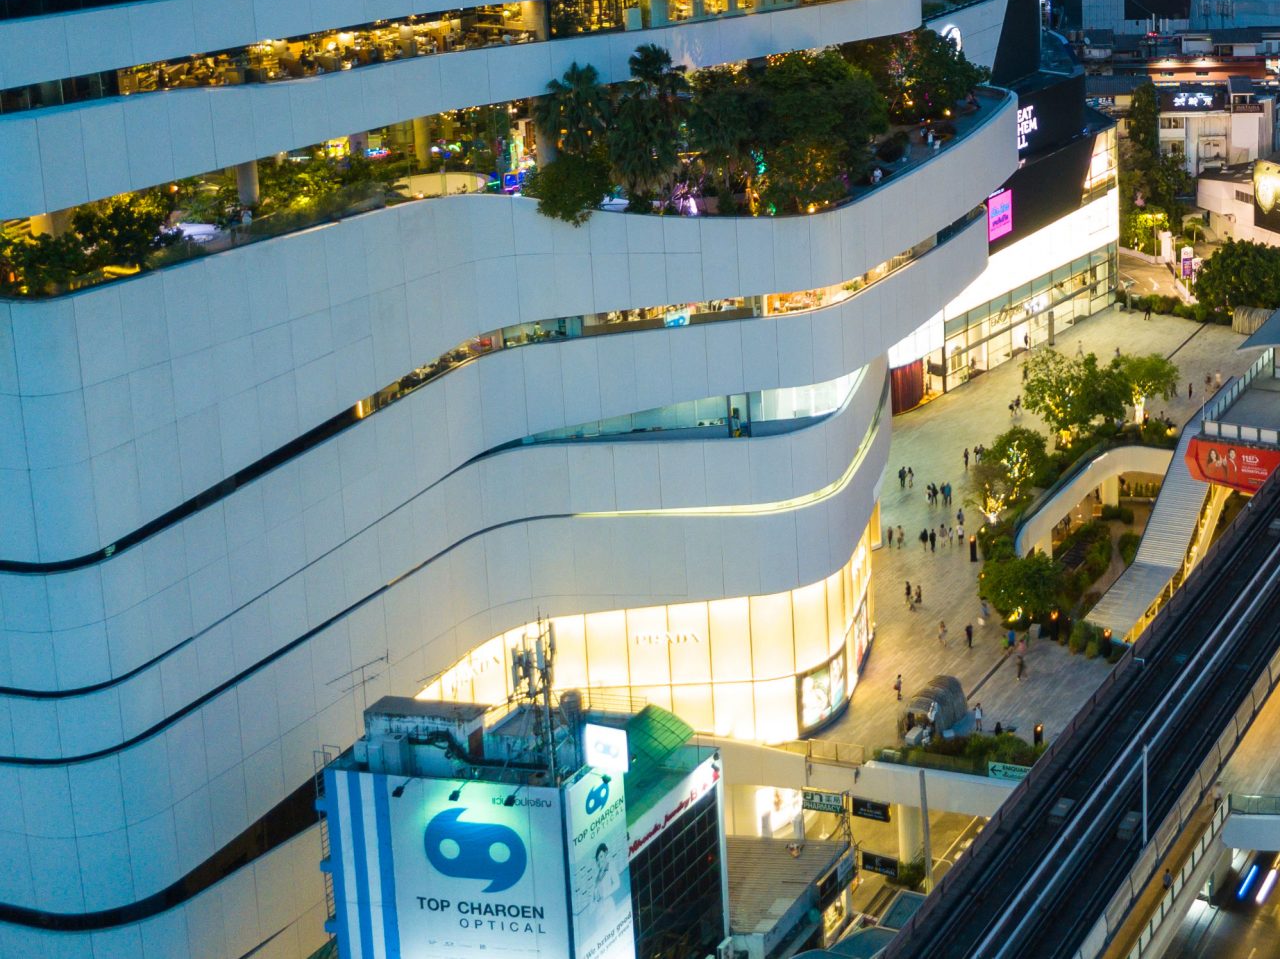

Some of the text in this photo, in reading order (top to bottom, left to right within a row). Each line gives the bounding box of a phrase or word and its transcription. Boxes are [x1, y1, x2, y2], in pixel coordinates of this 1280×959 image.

[1017, 117, 1038, 136] HEM
[1017, 134, 1029, 150] LL
[634, 631, 701, 646] PRADA
[803, 801, 841, 813] PHARMACY
[573, 795, 624, 846] TOP CHAROEN
[591, 806, 624, 840] OPTICAL
[416, 896, 545, 920] TOP CHAROEN
[459, 918, 546, 934] OPTICAL
